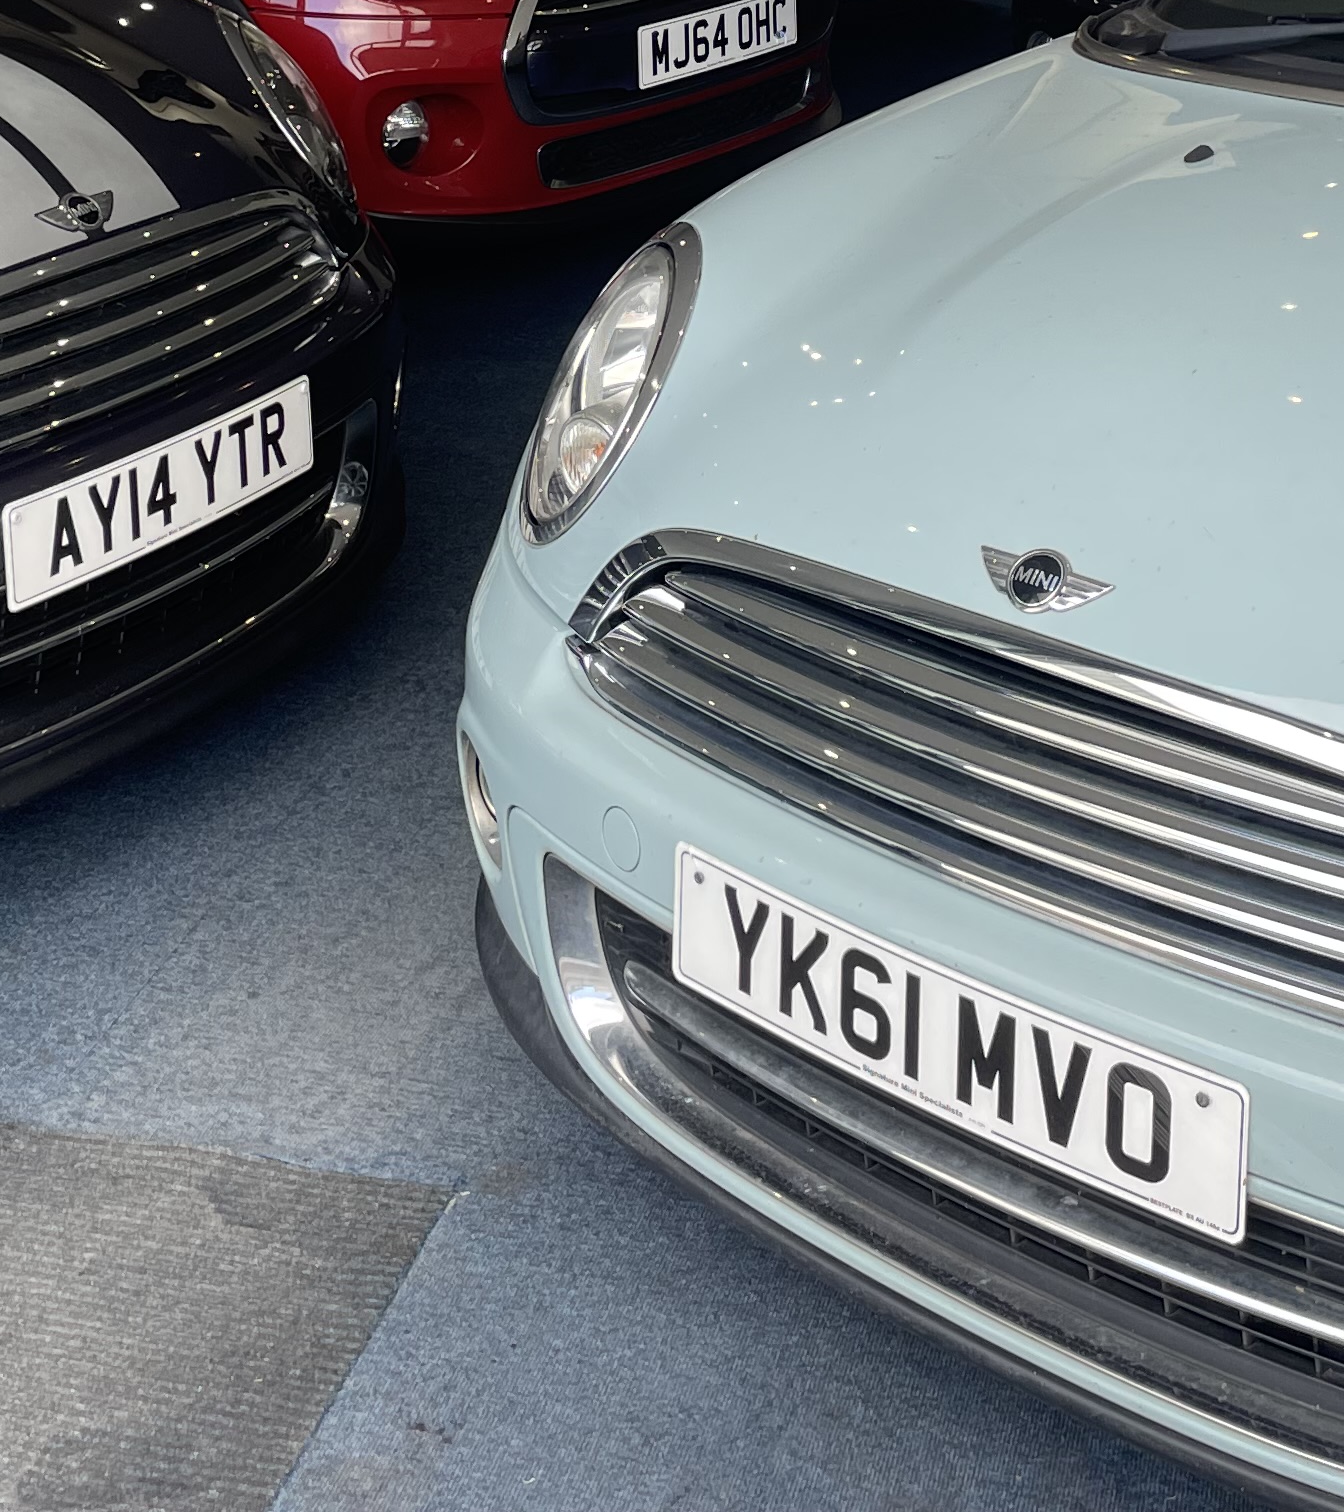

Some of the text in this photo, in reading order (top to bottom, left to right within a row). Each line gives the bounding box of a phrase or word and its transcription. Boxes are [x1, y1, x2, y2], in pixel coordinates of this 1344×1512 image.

[651, 13, 730, 77] MJ64
[49, 401, 288, 579] AY14 YTR
[1014, 565, 1060, 592] MINI
[723, 882, 1173, 1185] YK61 MVO
[862, 1063, 899, 1088] Signature
[900, 1081, 917, 1097] Mini
